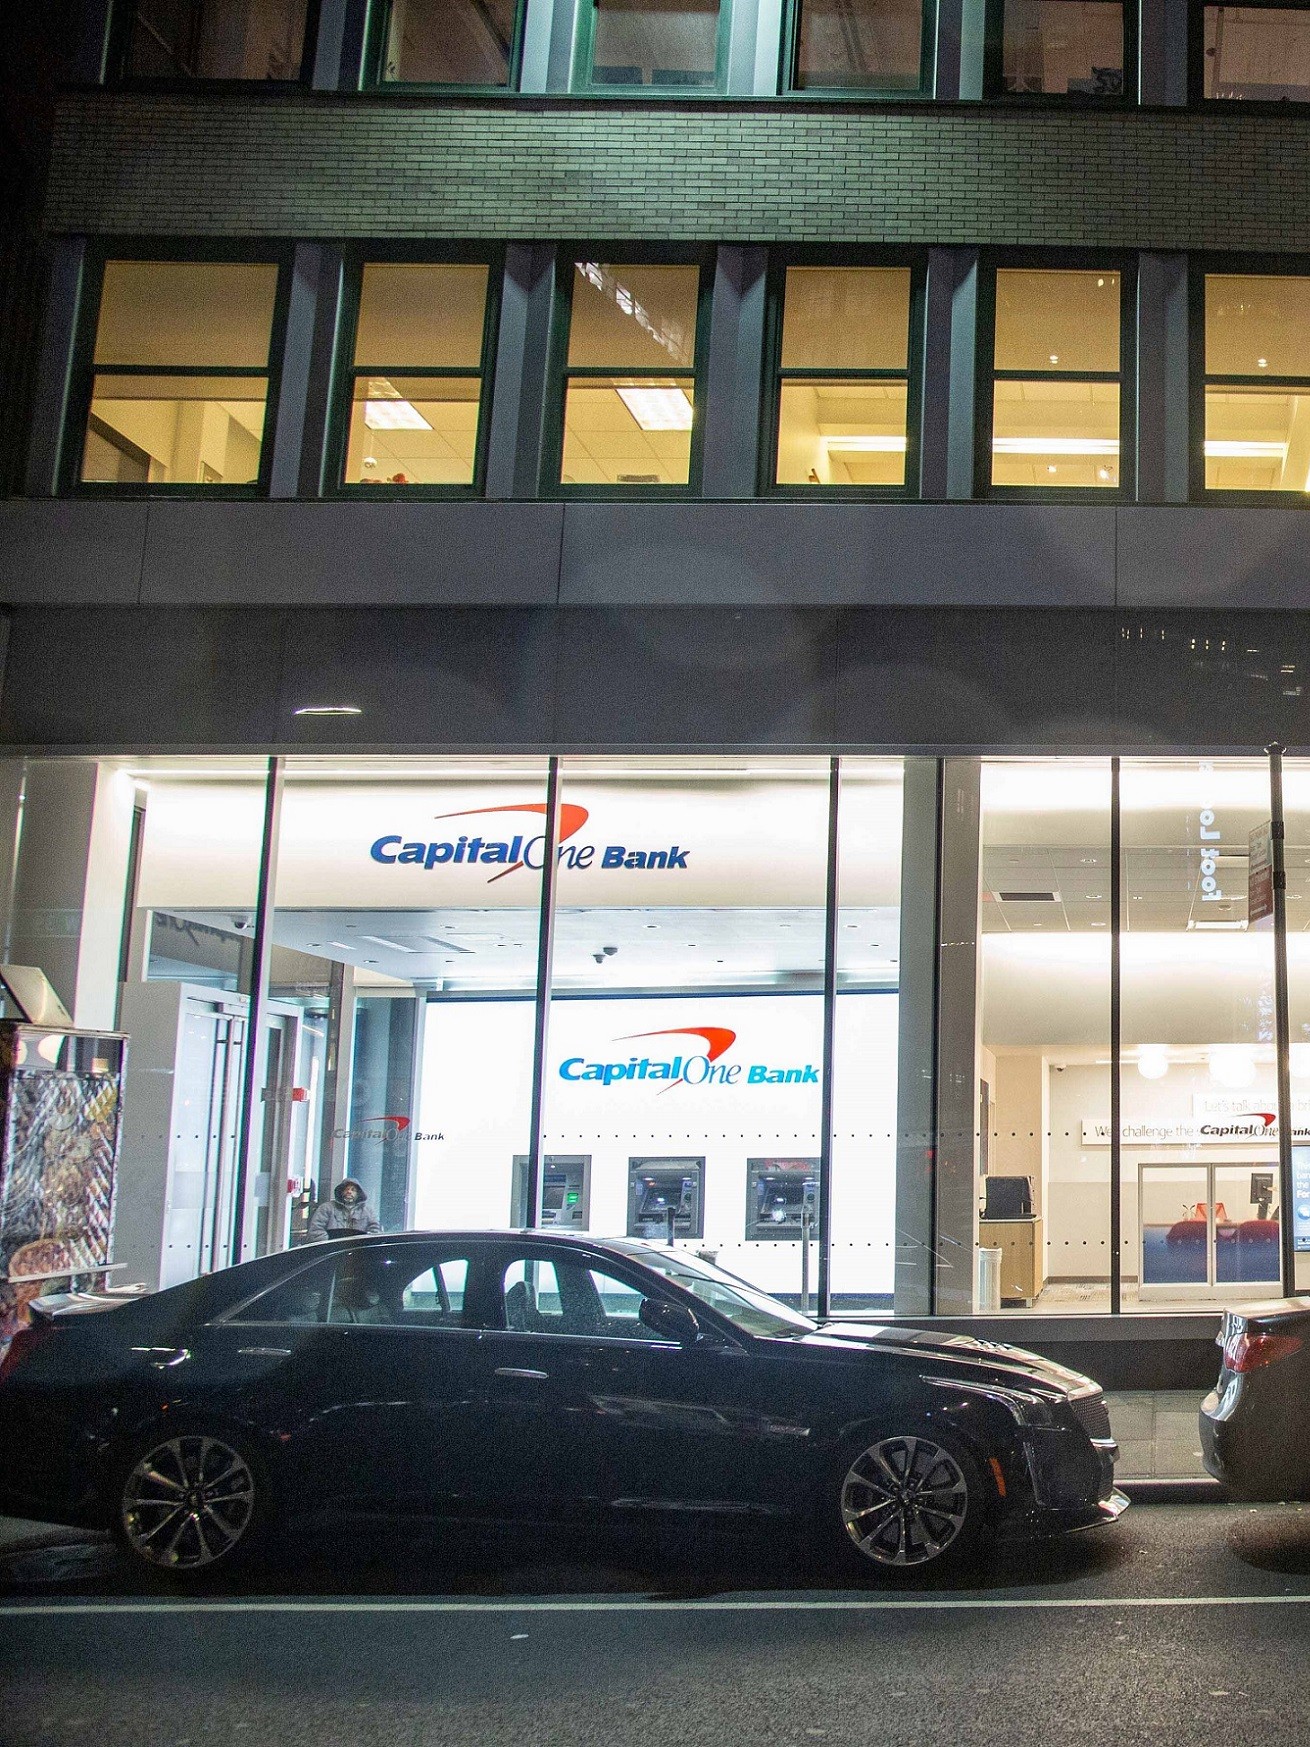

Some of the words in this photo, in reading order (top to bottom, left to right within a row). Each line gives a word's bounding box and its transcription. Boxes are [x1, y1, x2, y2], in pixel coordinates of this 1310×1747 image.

[601, 845, 691, 870] Bank
[747, 1064, 820, 1084] Bank
[414, 1132, 445, 1141] Bank
[1122, 1124, 1173, 1140] challenge
[1175, 1124, 1193, 1137] the
[1291, 1127, 1310, 1138] ank
[1296, 1181, 1309, 1189] the
[1296, 1190, 1309, 1199] For
